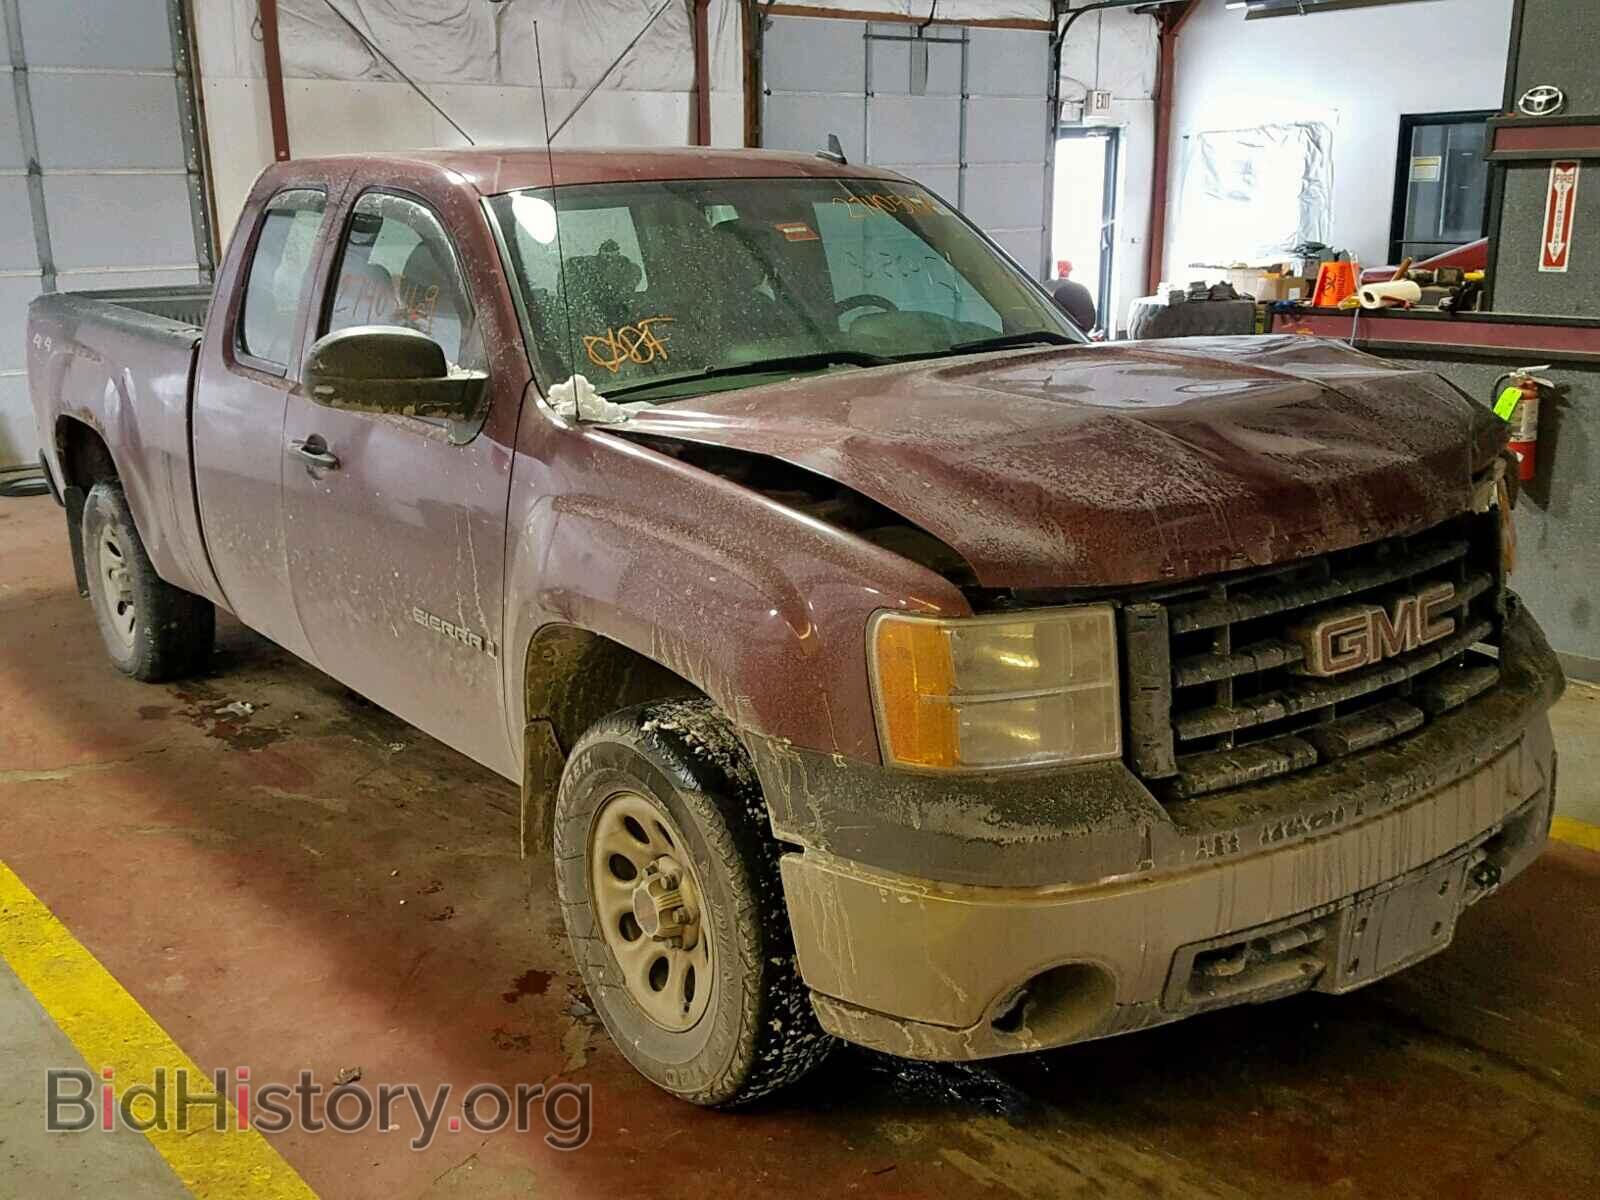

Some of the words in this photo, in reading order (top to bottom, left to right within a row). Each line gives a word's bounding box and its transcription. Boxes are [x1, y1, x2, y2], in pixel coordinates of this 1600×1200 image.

[1096, 92, 1111, 109] EXIT
[413, 606, 485, 652] SIERRA
[1313, 581, 1456, 678] GMC
